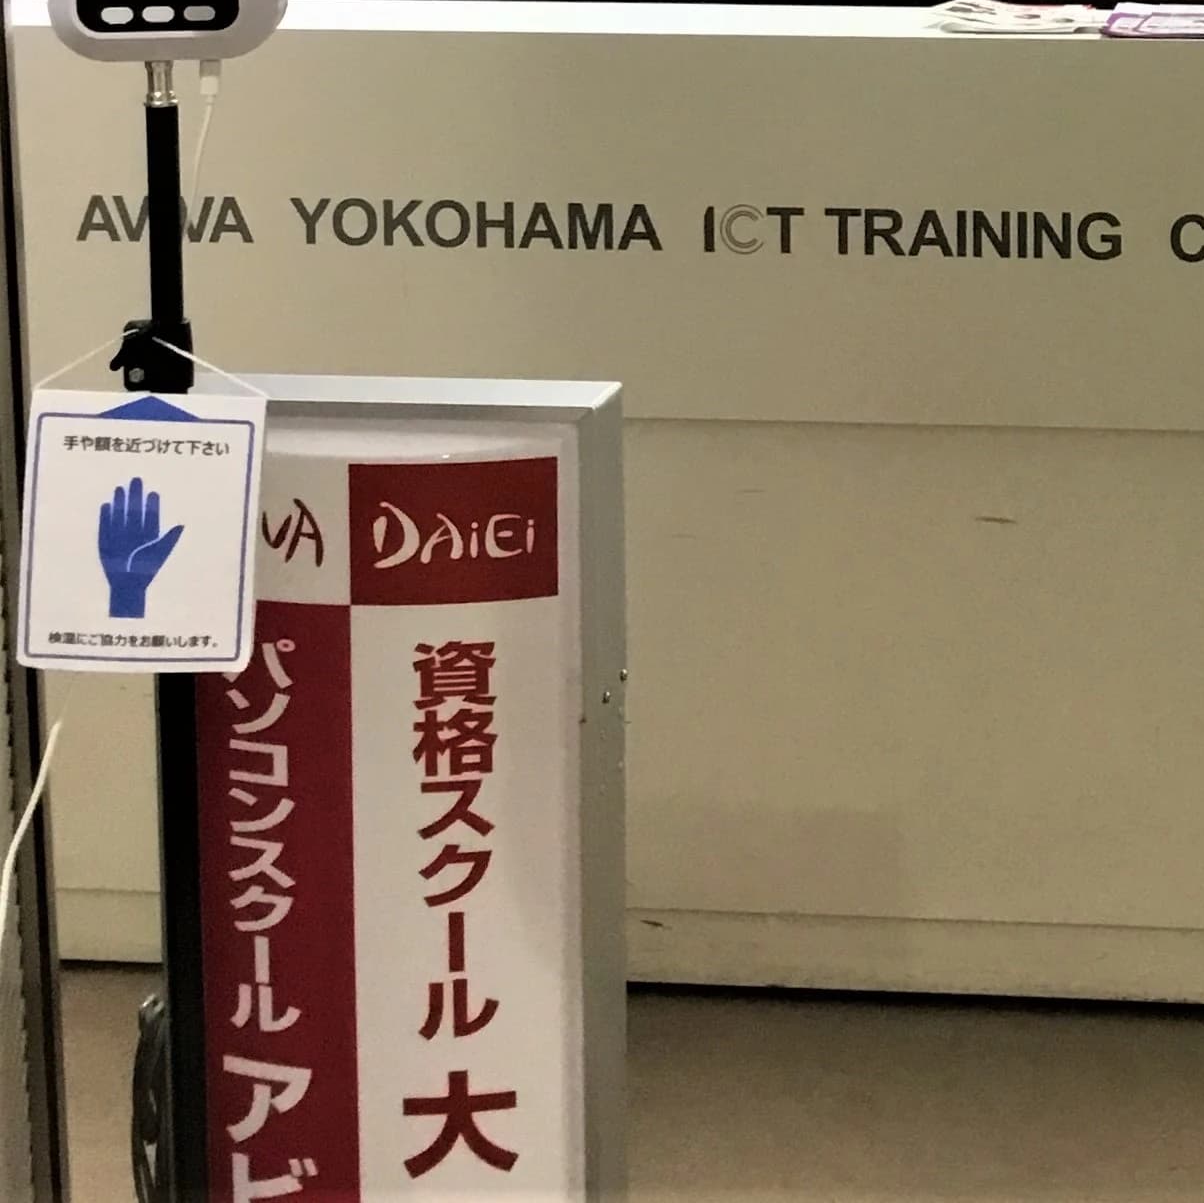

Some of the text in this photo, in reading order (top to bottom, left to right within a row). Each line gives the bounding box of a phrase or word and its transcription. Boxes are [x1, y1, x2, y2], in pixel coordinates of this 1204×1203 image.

[76, 194, 254, 244] AVVA
[289, 196, 663, 252] YOKOHAMA
[704, 203, 804, 256] ICT
[825, 206, 1123, 261] TRAINING
[63, 435, 230, 457] 手や額を近づけて下さい
[48, 630, 220, 649] 検温にご協力をお願いします。
[223, 638, 301, 1033] パソコンスクール
[402, 640, 519, 1180] 資格スクール 大
